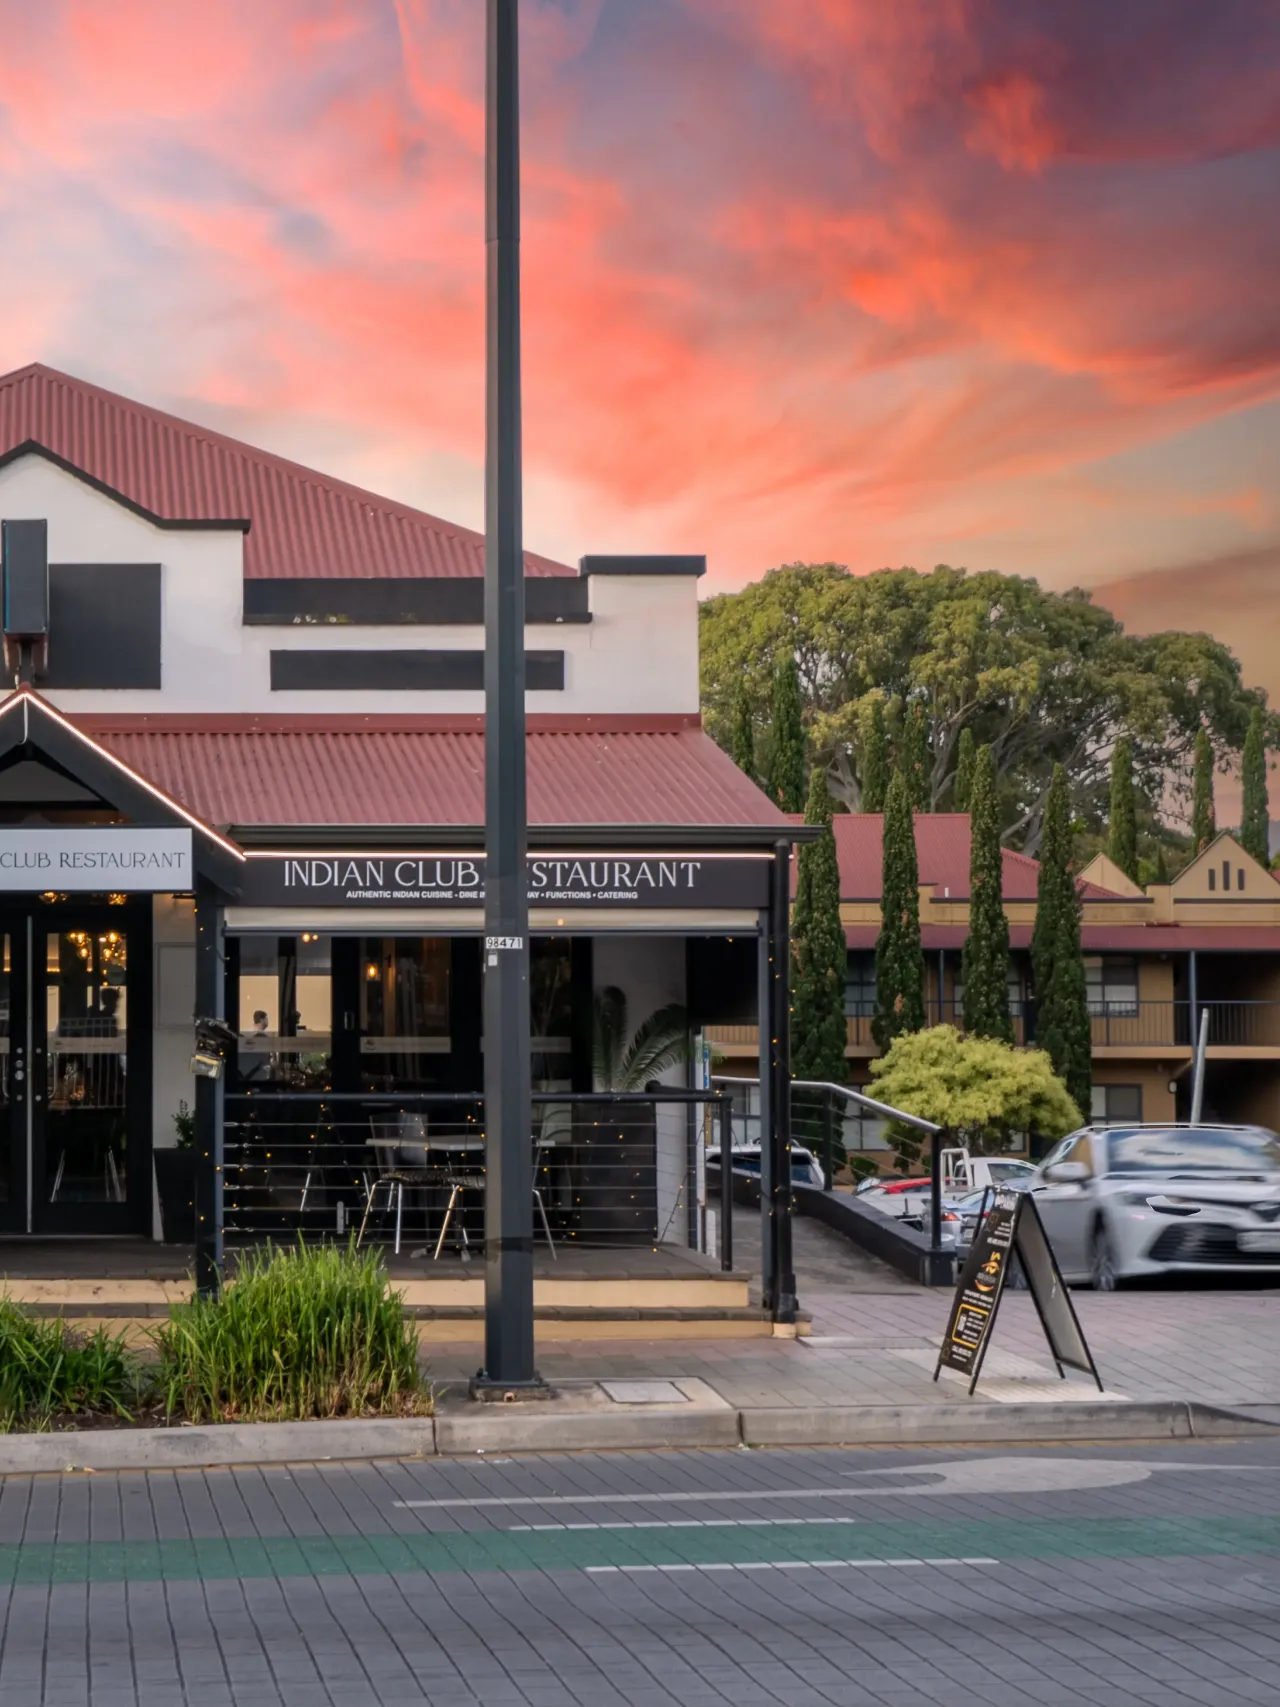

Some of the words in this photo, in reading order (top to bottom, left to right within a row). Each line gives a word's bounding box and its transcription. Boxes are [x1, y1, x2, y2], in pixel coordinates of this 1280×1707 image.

[0, 851, 51, 869] CLUB
[59, 851, 185, 869] RESTAURANT
[284, 860, 384, 887] INDIAN
[394, 860, 480, 887] CLUB
[482, 860, 701, 888] STAURANT
[346, 890, 391, 899] AUTHENTIC
[392, 890, 420, 899] INDIAN
[421, 890, 453, 899] CUISINE
[459, 890, 478, 899] DINE
[545, 891, 592, 899] FUNCTIONS
[597, 891, 638, 899] CATERING
[487, 937, 521, 948] 98471
